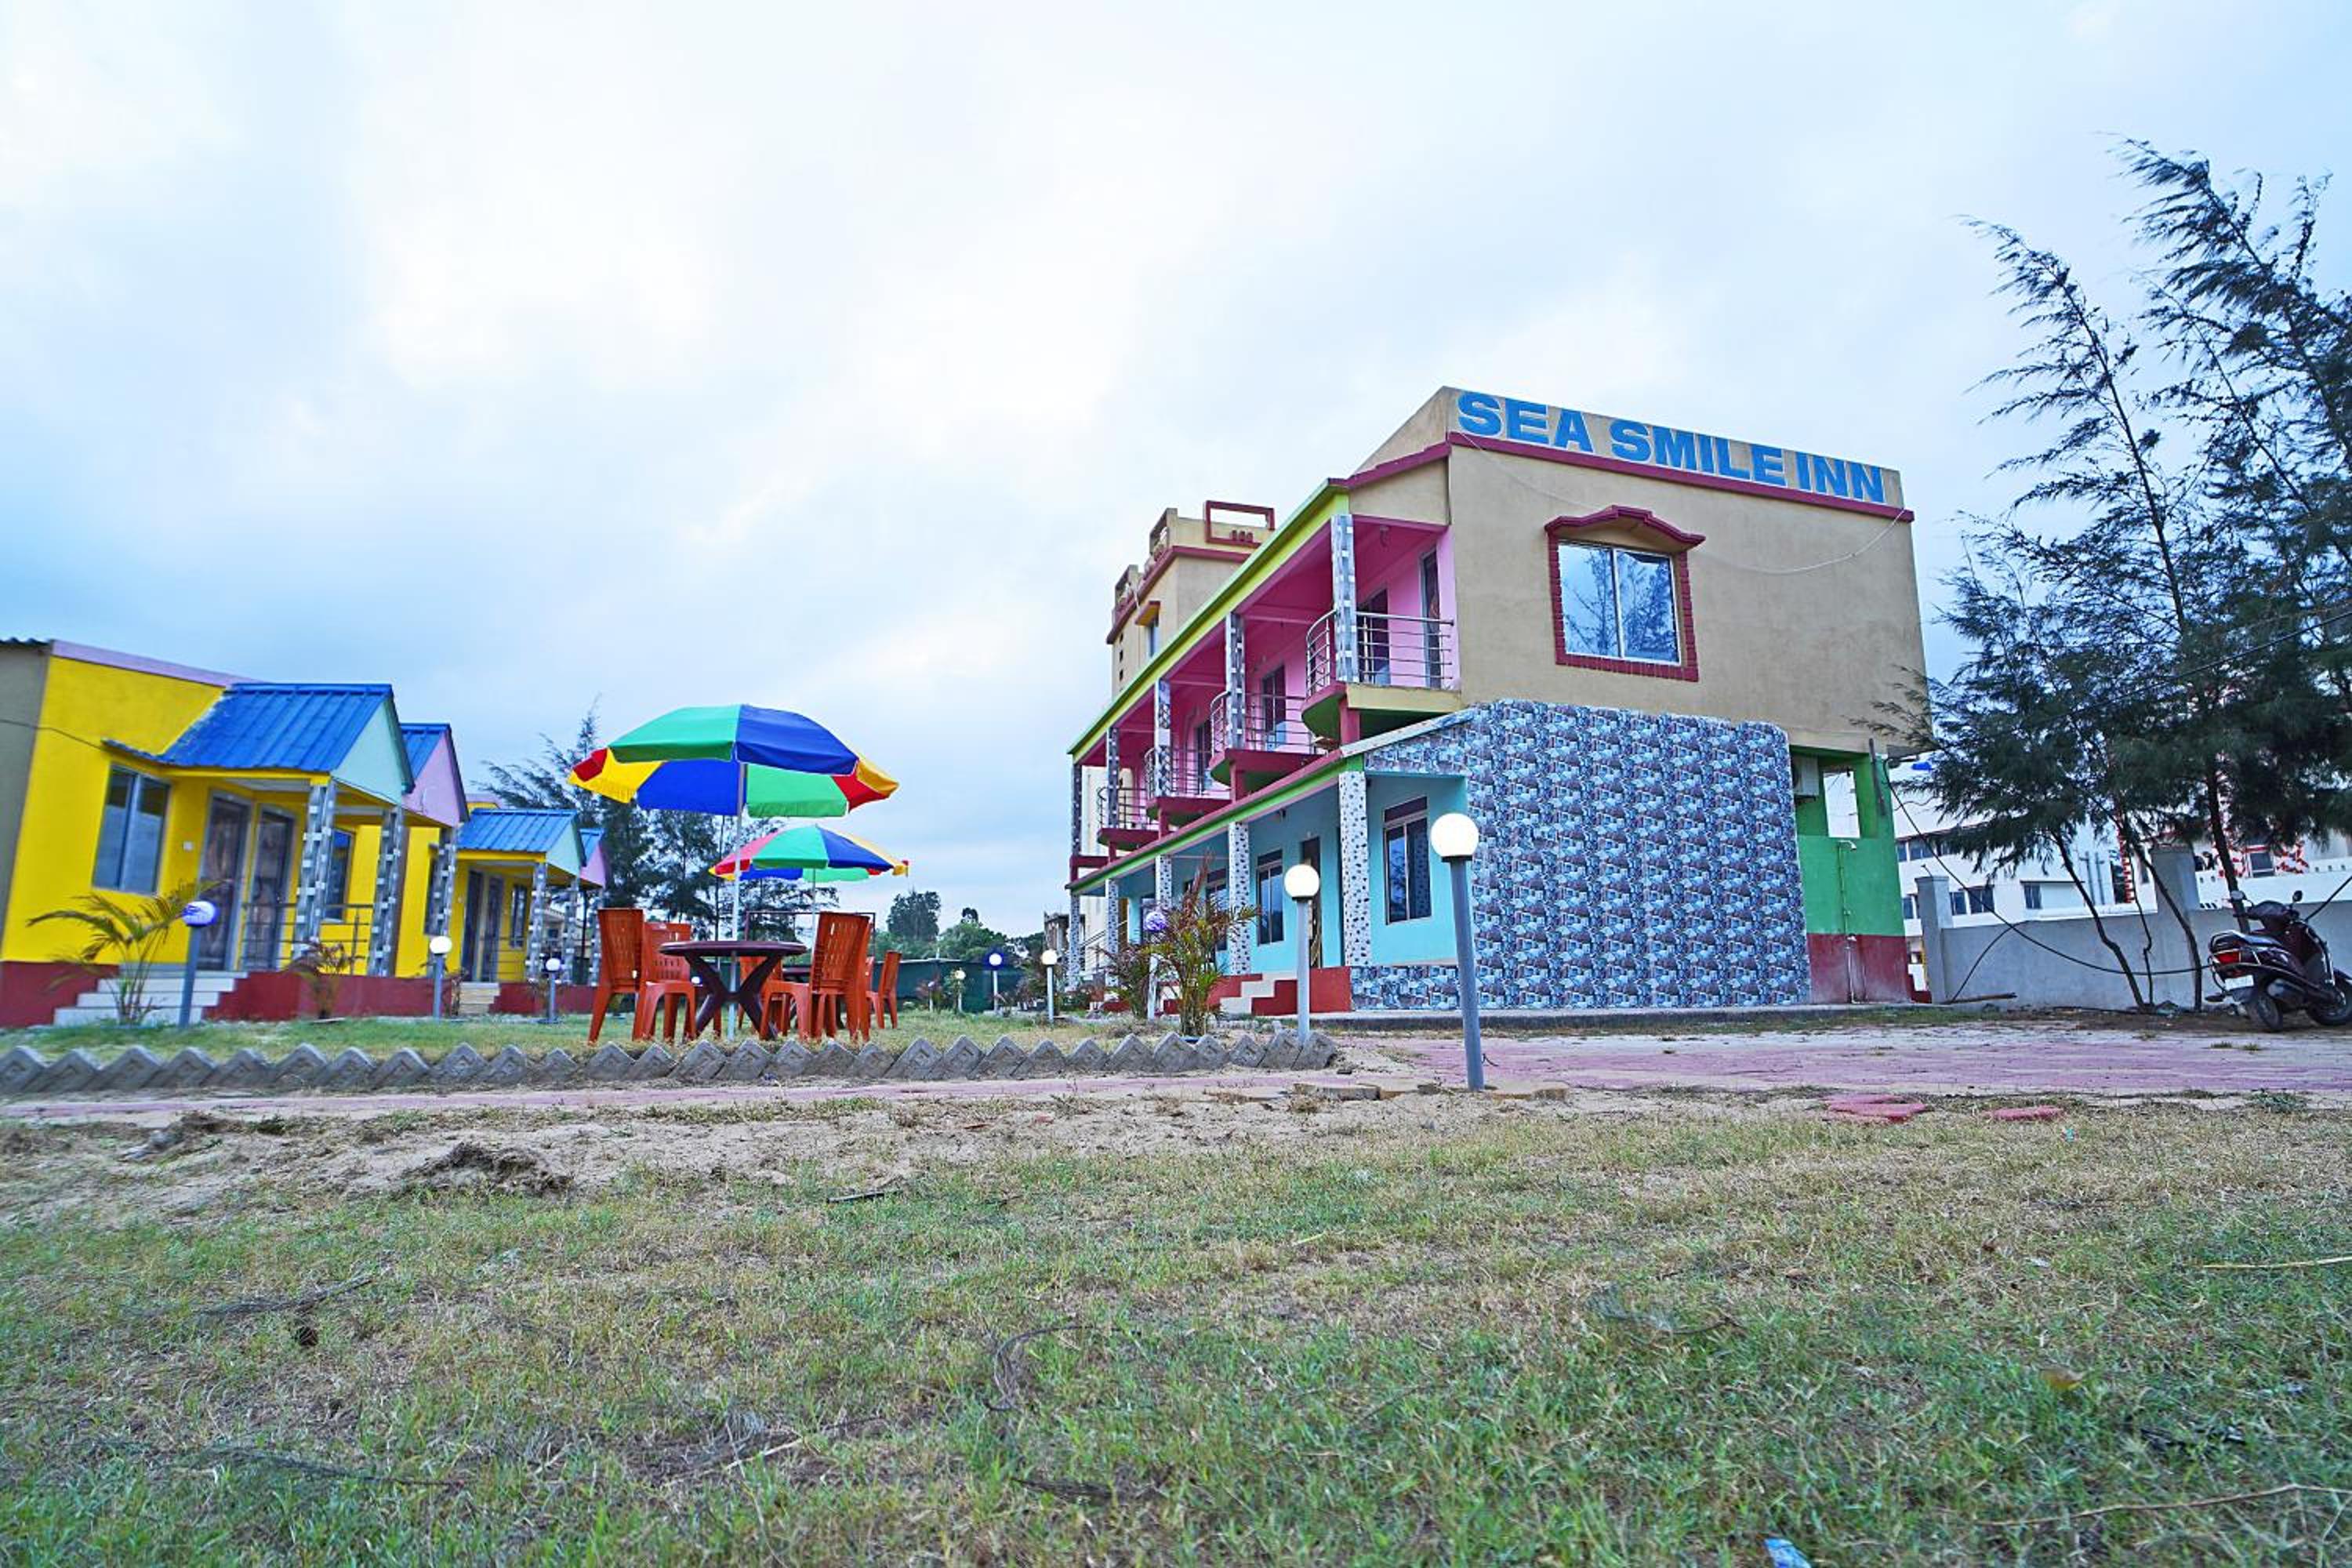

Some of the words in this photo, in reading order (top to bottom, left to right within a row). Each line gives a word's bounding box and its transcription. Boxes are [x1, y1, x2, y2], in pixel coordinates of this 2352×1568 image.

[1457, 391, 1594, 452] SEA
[1610, 418, 1786, 486] SMILE
[1797, 452, 1885, 503] INN
